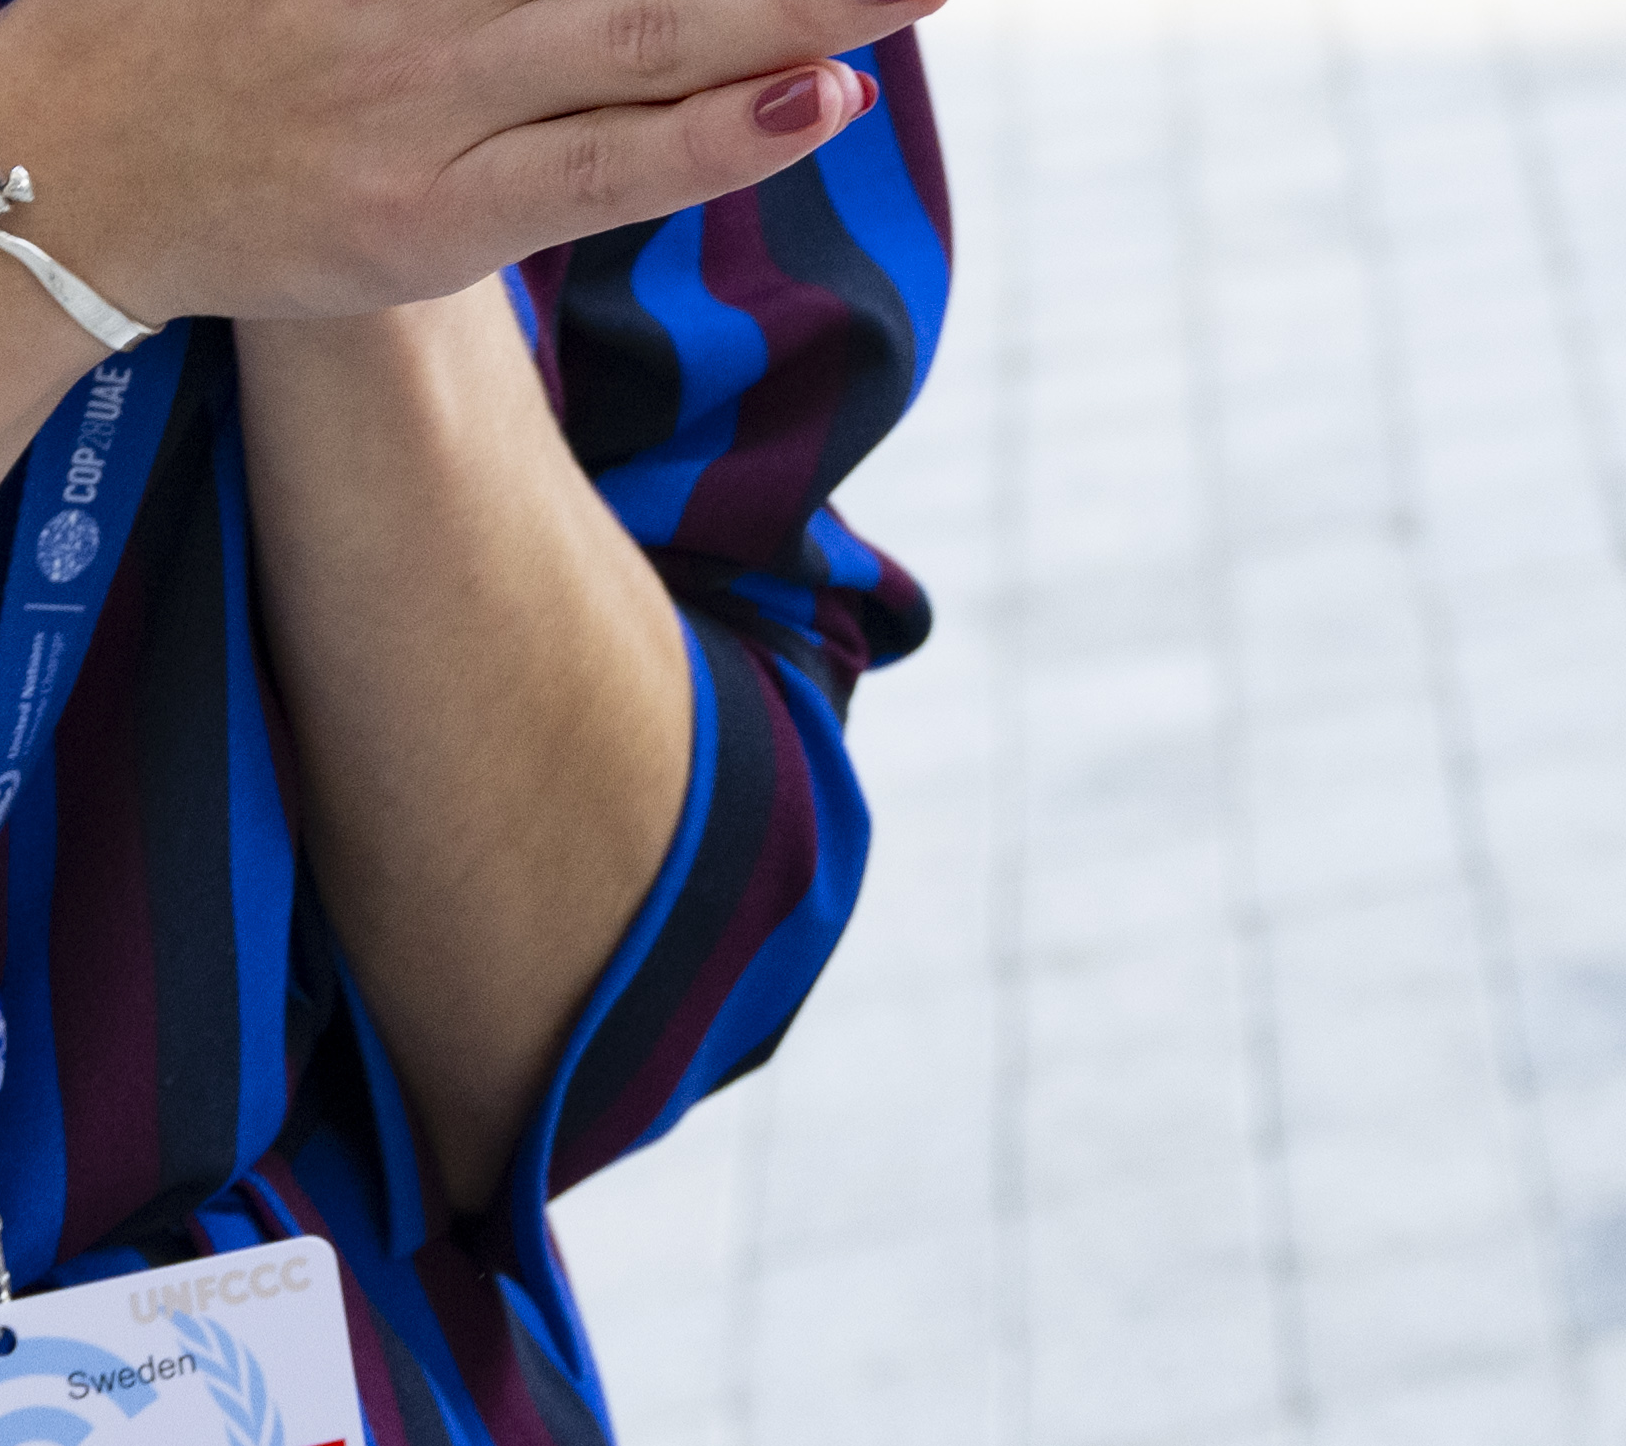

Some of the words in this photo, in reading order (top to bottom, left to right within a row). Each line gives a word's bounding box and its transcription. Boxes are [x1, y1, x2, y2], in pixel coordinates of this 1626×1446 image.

[62, 364, 132, 505] COP28UAE
[128, 1255, 313, 1325] UNFCCC
[66, 1352, 199, 1401] Sweden
